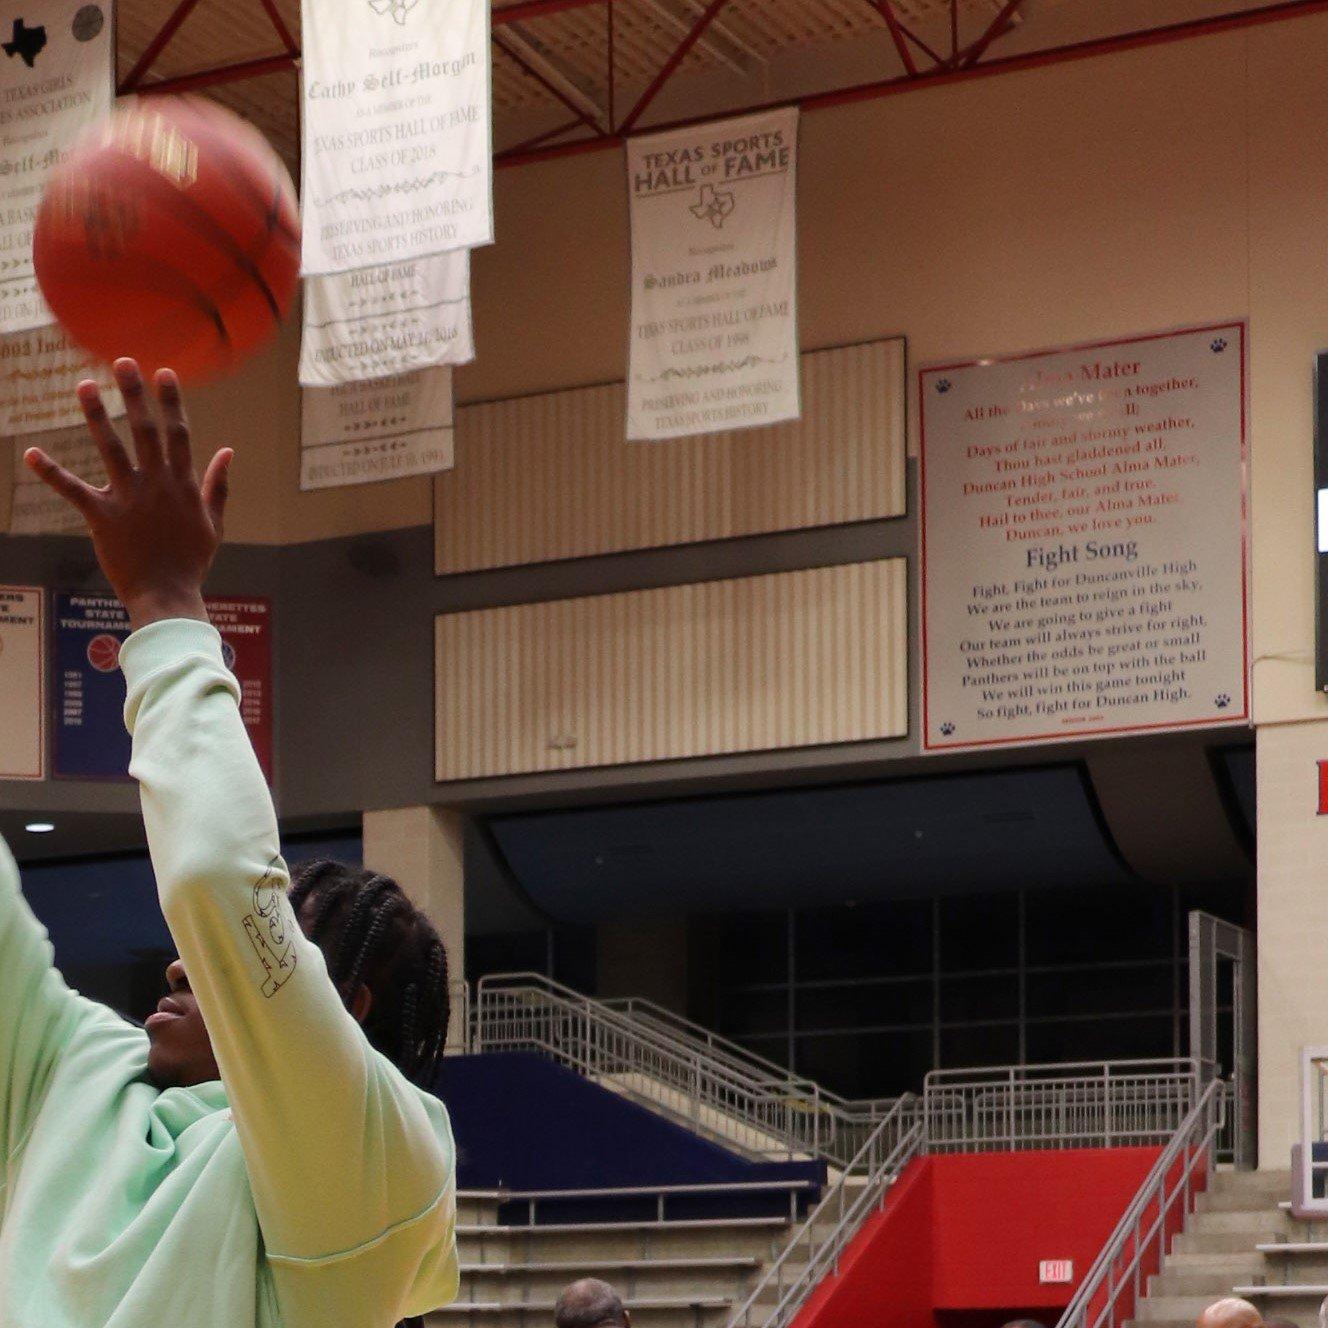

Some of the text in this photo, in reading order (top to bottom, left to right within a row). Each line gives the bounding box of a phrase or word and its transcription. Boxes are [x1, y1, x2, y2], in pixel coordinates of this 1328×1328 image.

[308, 50, 477, 100] Cathy Self-Morgan
[644, 130, 784, 170] TEXAS SPORTS
[634, 164, 697, 193] HALL
[725, 145, 791, 178] FAME
[1080, 361, 1142, 381] Mater
[963, 478, 1017, 497] Duncan
[1022, 471, 1056, 489] High
[1112, 459, 1150, 475] Alma
[1096, 499, 1134, 513] Alma
[1026, 540, 1139, 572] Fight Song
[1014, 578, 1048, 595] Fight
[1051, 573, 1072, 588] for
[1075, 564, 1159, 586] Duncanville
[1163, 560, 1198, 578] High
[70, 597, 127, 609] PANTHE
[84, 608, 124, 620] STATE
[967, 602, 987, 618] We
[992, 601, 1013, 614] are
[1015, 597, 1037, 611] the
[1040, 594, 1073, 609] team
[1076, 591, 1090, 605] to
[1150, 580, 1172, 595] the
[59, 618, 131, 631] TOURNAME
[210, 613, 238, 623] TATE
[988, 618, 1010, 633] We
[1013, 616, 1034, 629] are
[1037, 610, 1077, 628] going
[1079, 608, 1093, 622] to
[1096, 605, 1126, 622] give
[1139, 600, 1174, 617] fight
[959, 638, 985, 653] Our
[989, 634, 1022, 649] team
[1026, 631, 1052, 647] will
[1055, 626, 1102, 644] always
[1147, 617, 1167, 632] for
[966, 631, 1202, 671] Whether the odds be great or small
[961, 671, 1020, 689] Panthers
[1023, 665, 1049, 681] will
[1053, 662, 1070, 678] be
[1093, 659, 1117, 676] top
[1120, 656, 1150, 671] with
[1154, 652, 1176, 667] the
[1180, 650, 1207, 665] ball
[982, 668, 1186, 702] We will win this game tonight
[976, 707, 993, 720] So
[1036, 700, 1069, 717] fight
[1072, 697, 1091, 710] for
[1096, 693, 1150, 710] Duncan
[1045, 1261, 1066, 1281] EXIT
